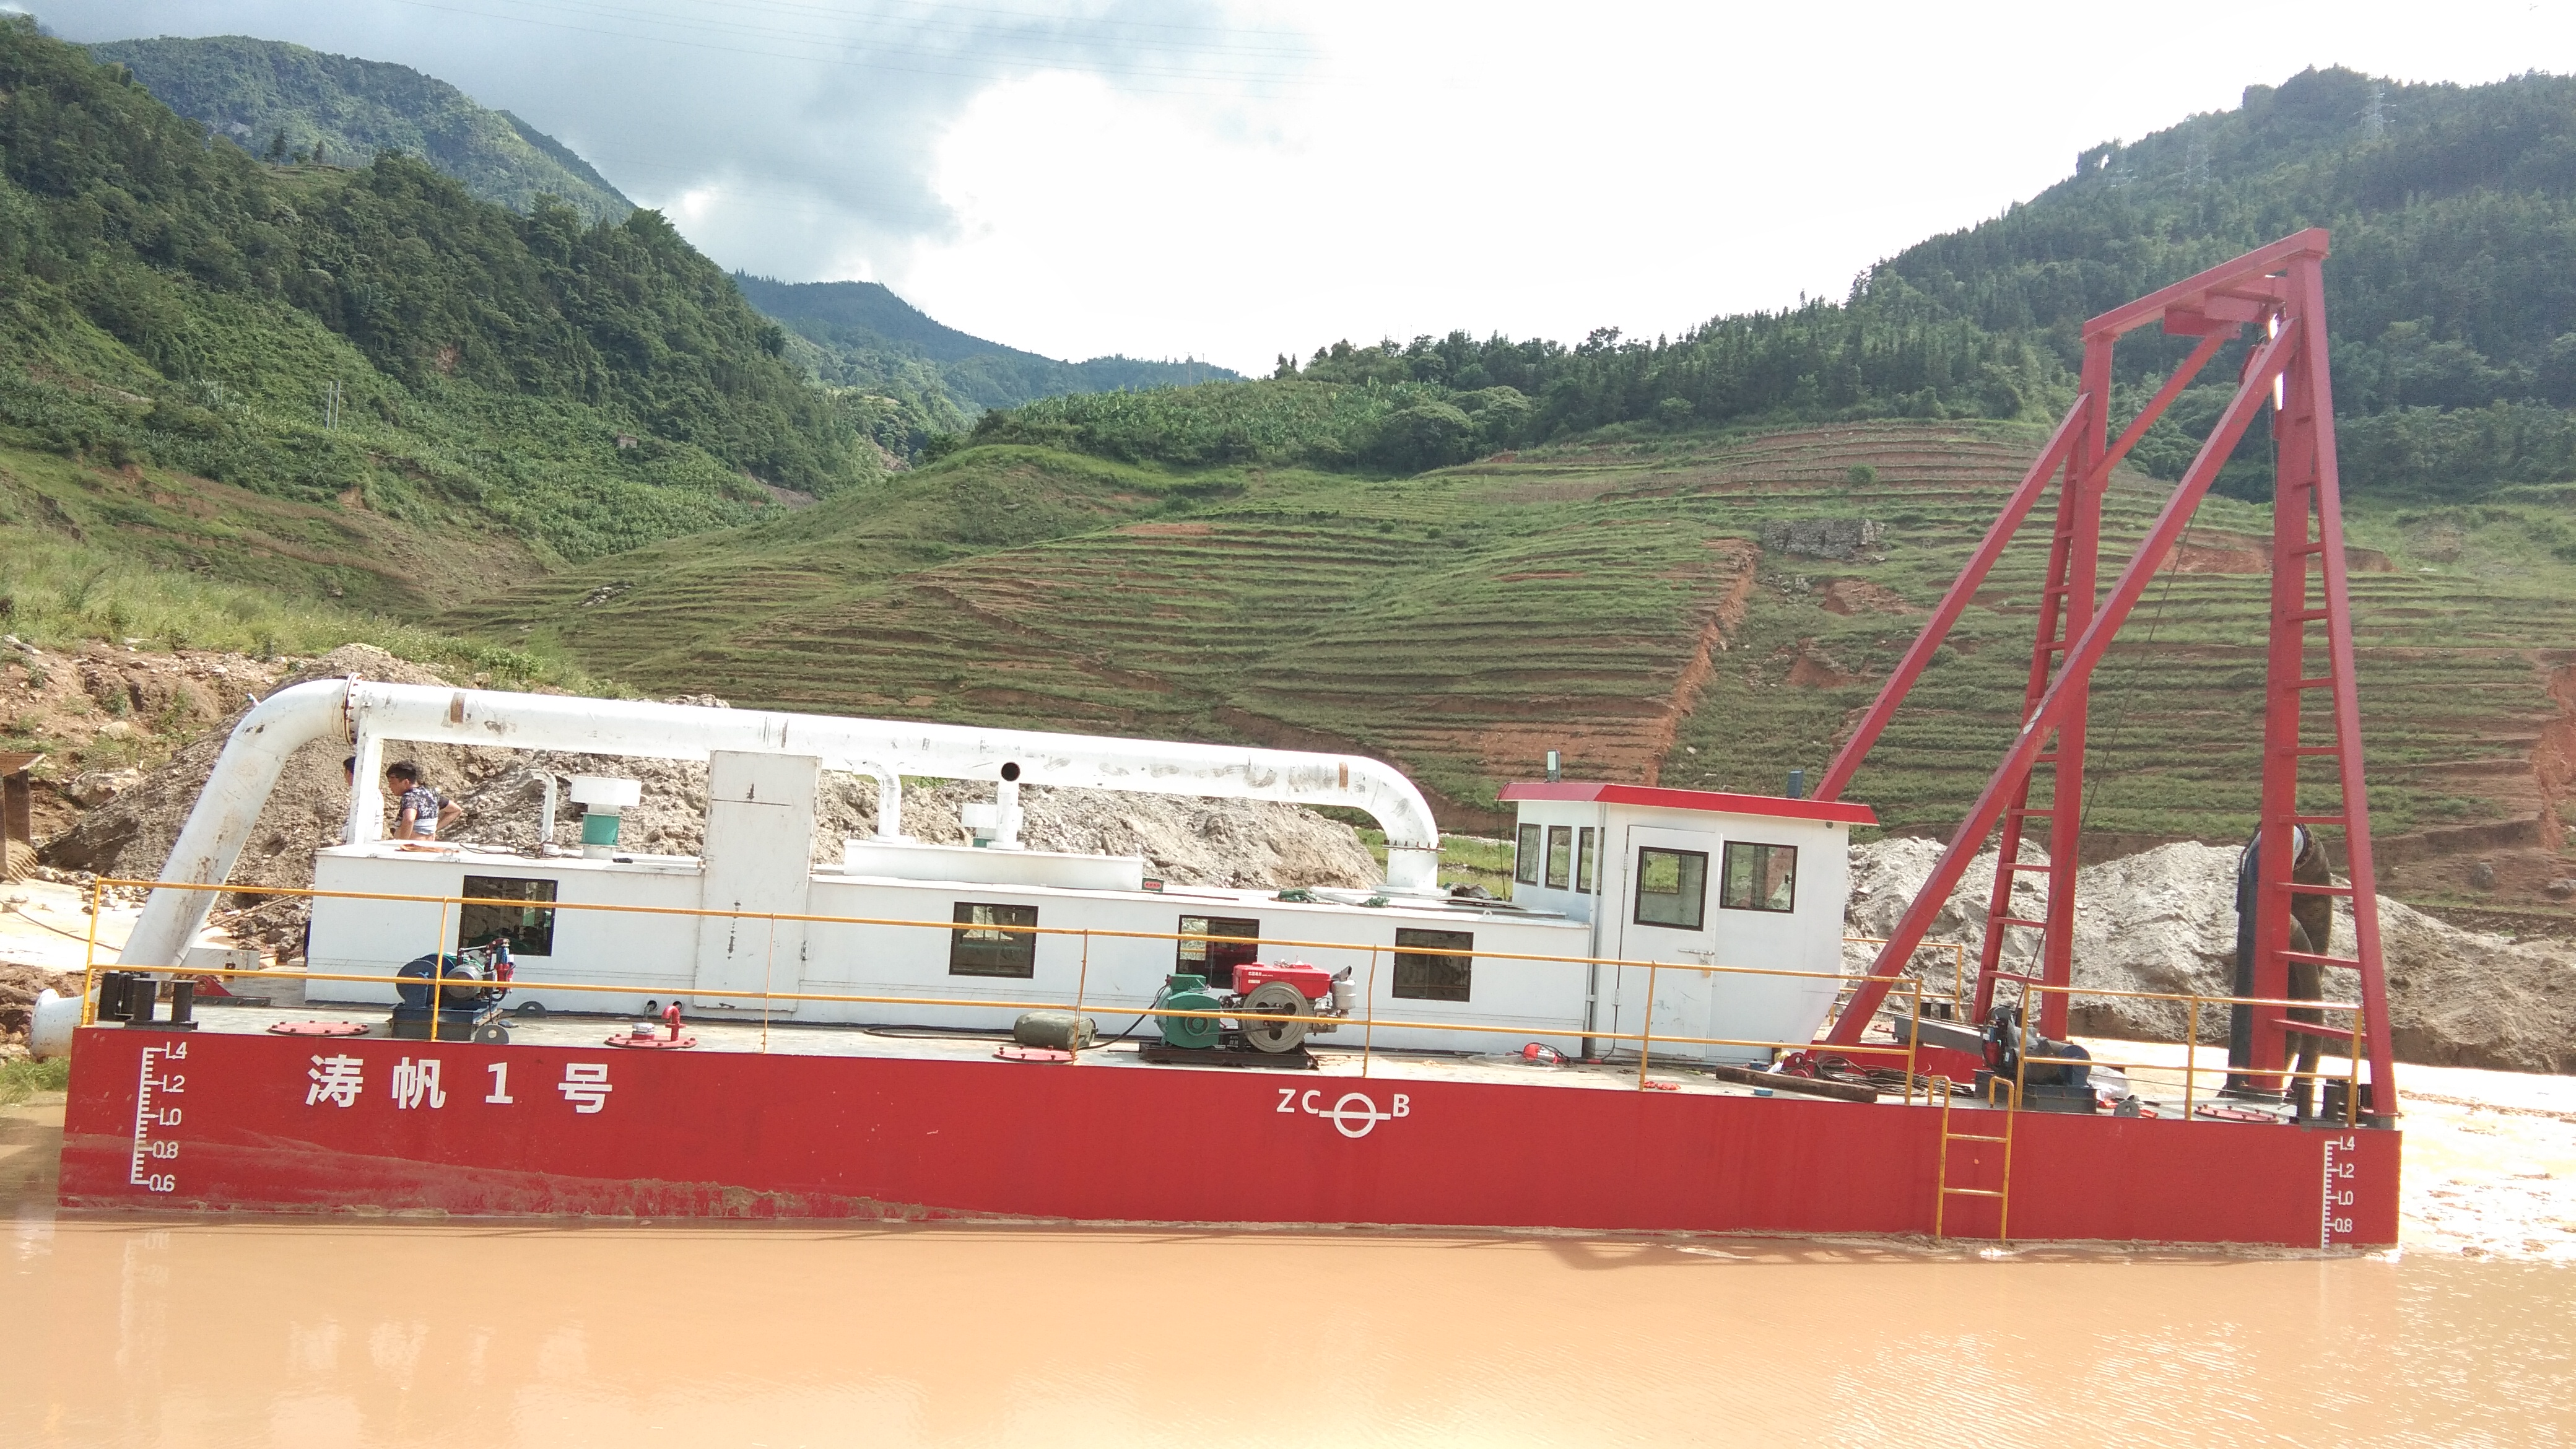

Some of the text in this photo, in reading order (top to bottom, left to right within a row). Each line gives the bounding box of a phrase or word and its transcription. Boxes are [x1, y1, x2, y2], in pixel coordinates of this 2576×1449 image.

[305, 1053, 613, 1114] 涛帆1号
[1276, 1089, 1410, 1117] ZC B
[152, 1141, 179, 1159] 0.8
[149, 1174, 176, 1192] 0.6
[2334, 1218, 2352, 1232] 0.8
